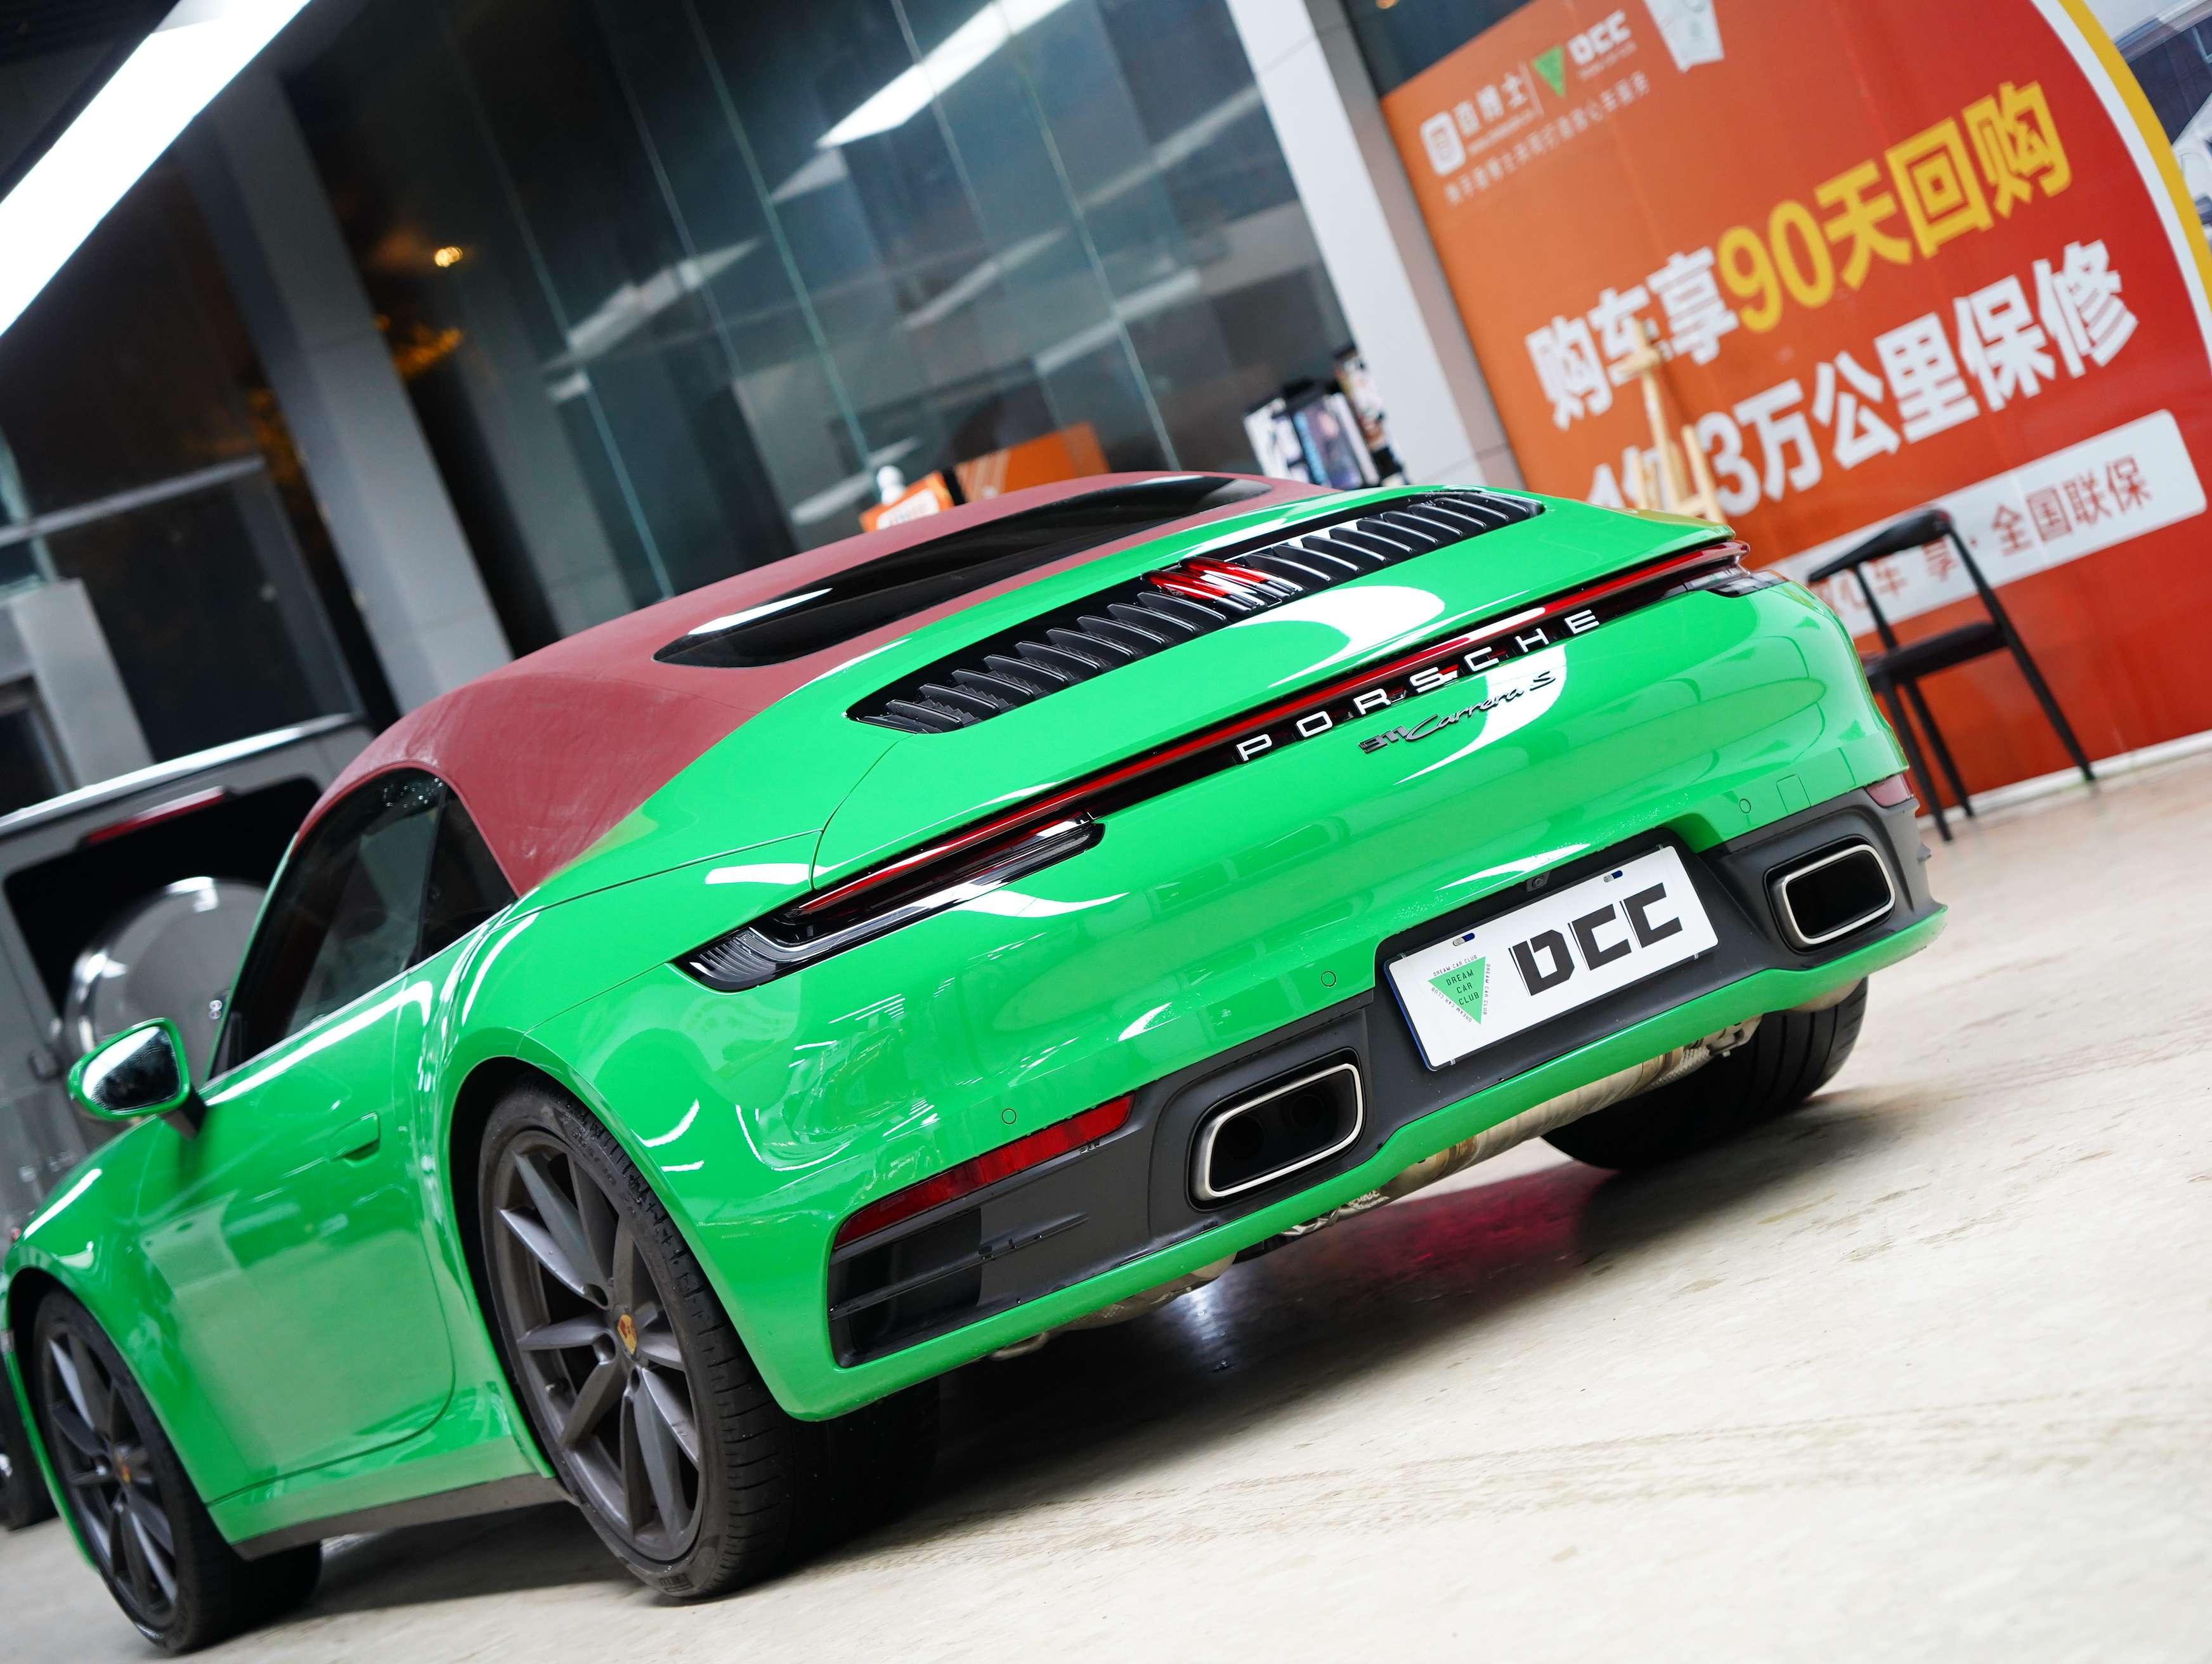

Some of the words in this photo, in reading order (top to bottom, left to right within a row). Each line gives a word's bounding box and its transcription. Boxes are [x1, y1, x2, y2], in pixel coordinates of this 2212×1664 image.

[1525, 81, 2074, 431] 购车享90天回购
[1585, 240, 2140, 517] 3万公里保修
[1235, 609, 1600, 762] PORSCHE
[1404, 687, 1525, 742] Carrera
[1530, 670, 1556, 691] S
[1446, 969, 1474, 985] DREAM
[1508, 882, 1683, 996] DCC
[1456, 982, 1473, 994] CAR
[1459, 992, 1480, 1006] CLUB
